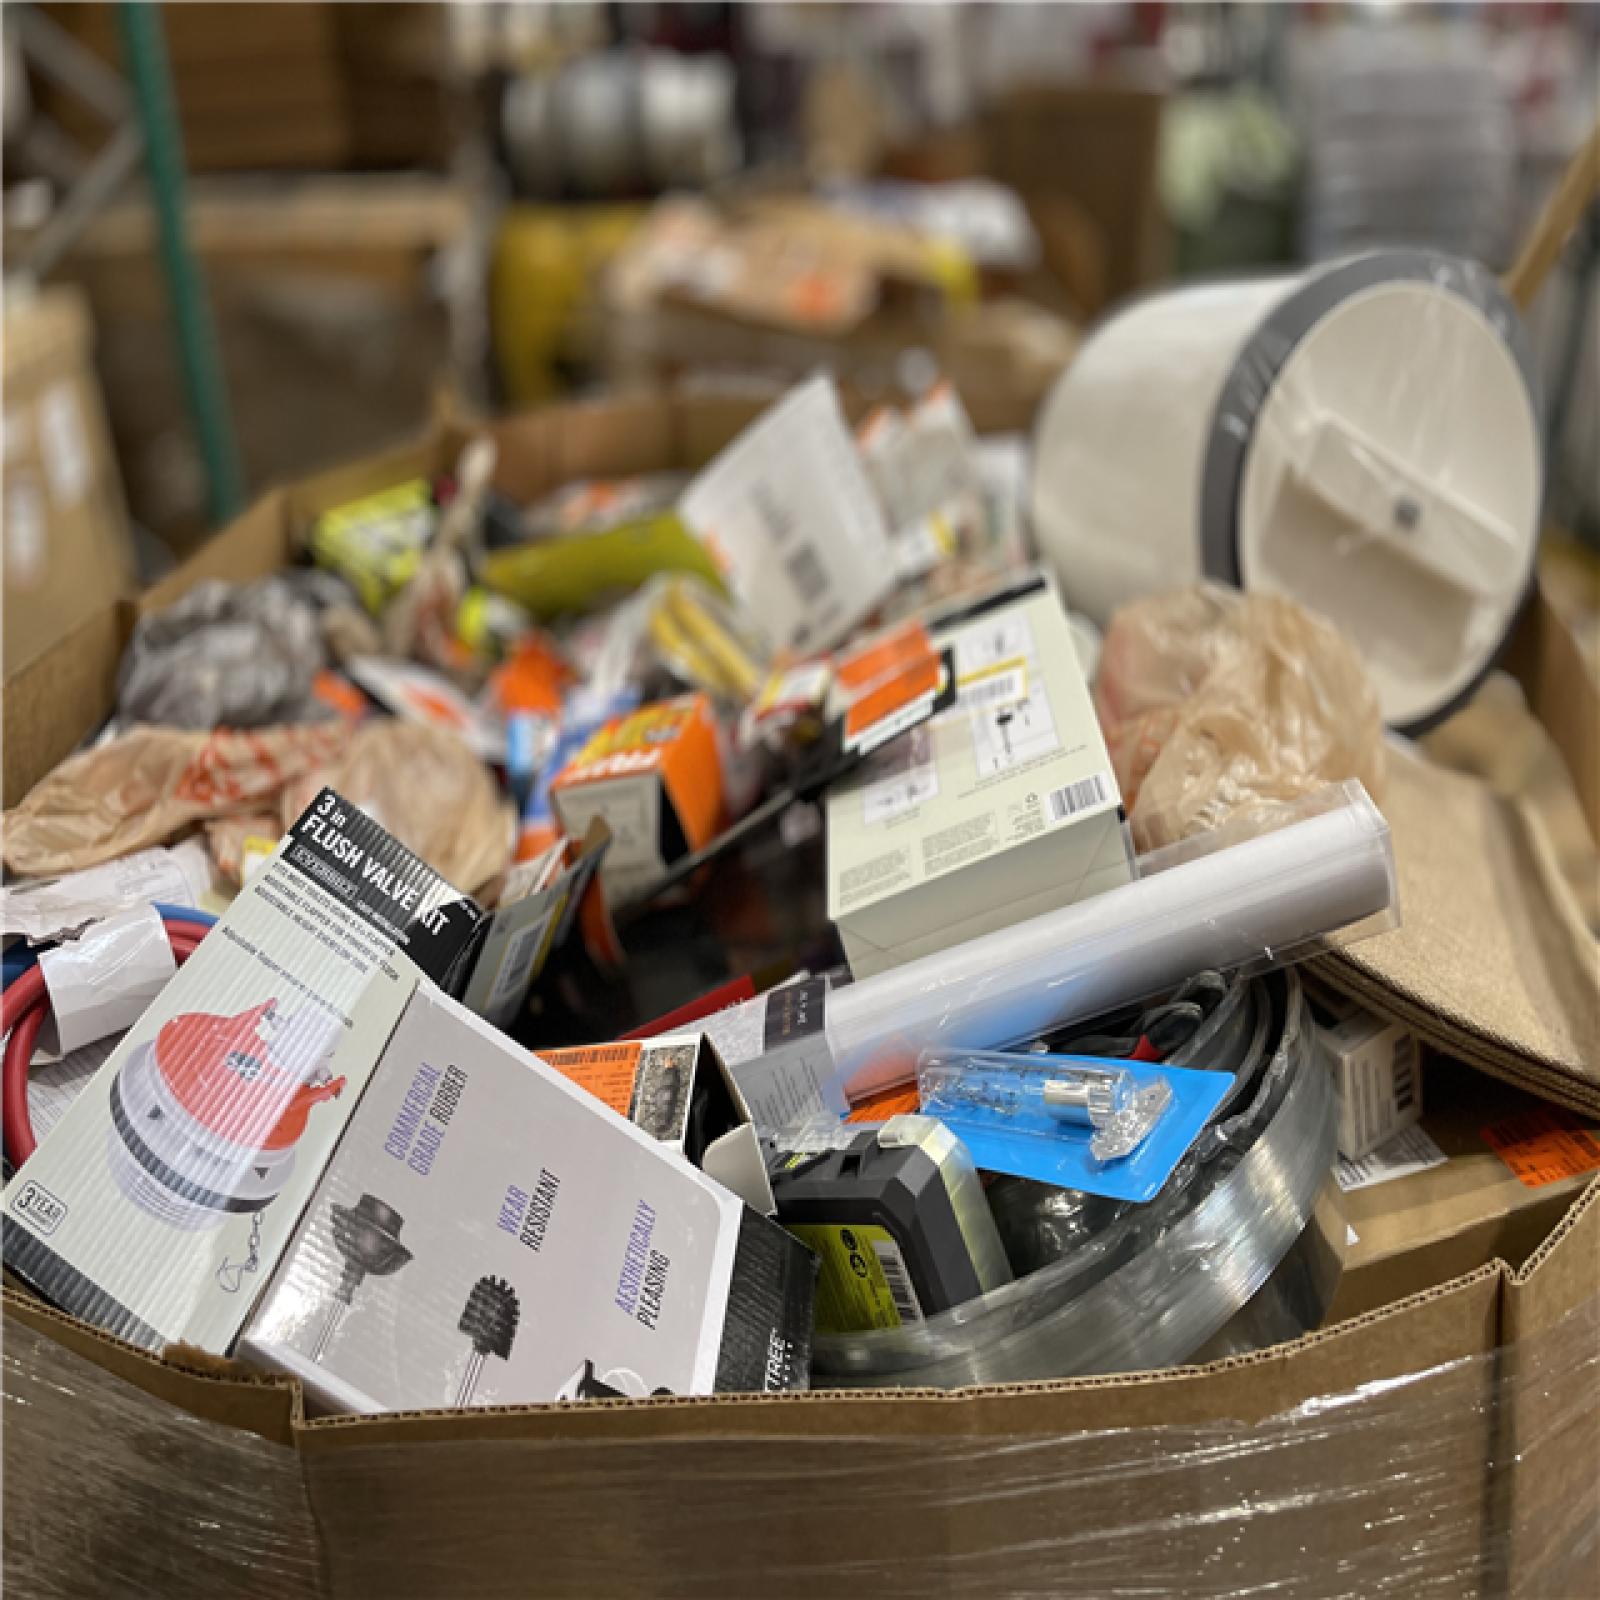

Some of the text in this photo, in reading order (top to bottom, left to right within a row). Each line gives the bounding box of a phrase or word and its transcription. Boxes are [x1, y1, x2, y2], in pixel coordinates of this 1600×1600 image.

[317, 795, 336, 815] 3
[302, 814, 365, 868] FLUSH
[362, 856, 419, 909] VALVE
[384, 1062, 440, 1160] COMMERCIAL
[407, 1064, 468, 1175] GRADE RUBBER
[17, 1187, 36, 1208] 3
[497, 1184, 529, 1236] WEAR
[518, 1167, 561, 1252] RESISTANT
[614, 1199, 656, 1316] AESTHETICALLY
[636, 1249, 671, 1331] PLEASING
